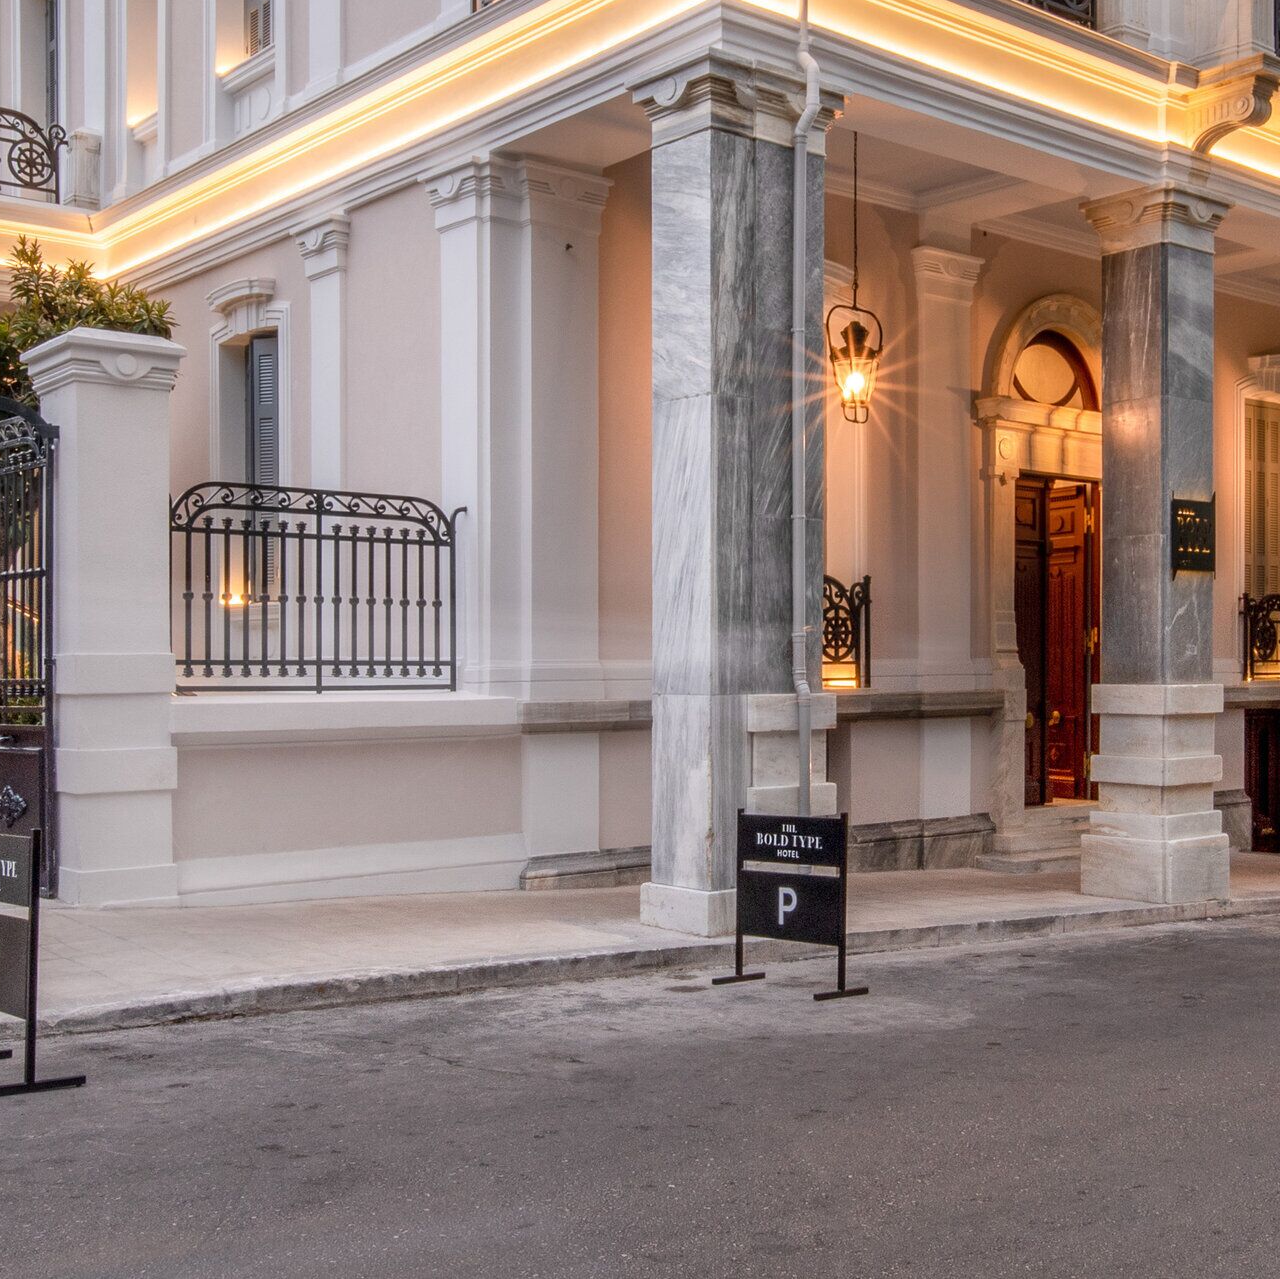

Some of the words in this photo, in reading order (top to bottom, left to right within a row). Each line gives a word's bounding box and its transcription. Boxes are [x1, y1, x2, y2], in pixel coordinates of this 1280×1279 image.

[756, 832, 789, 847] BOLD
[792, 835, 823, 850] TYPE
[777, 849, 799, 859] HOTEL
[778, 886, 798, 926] P
